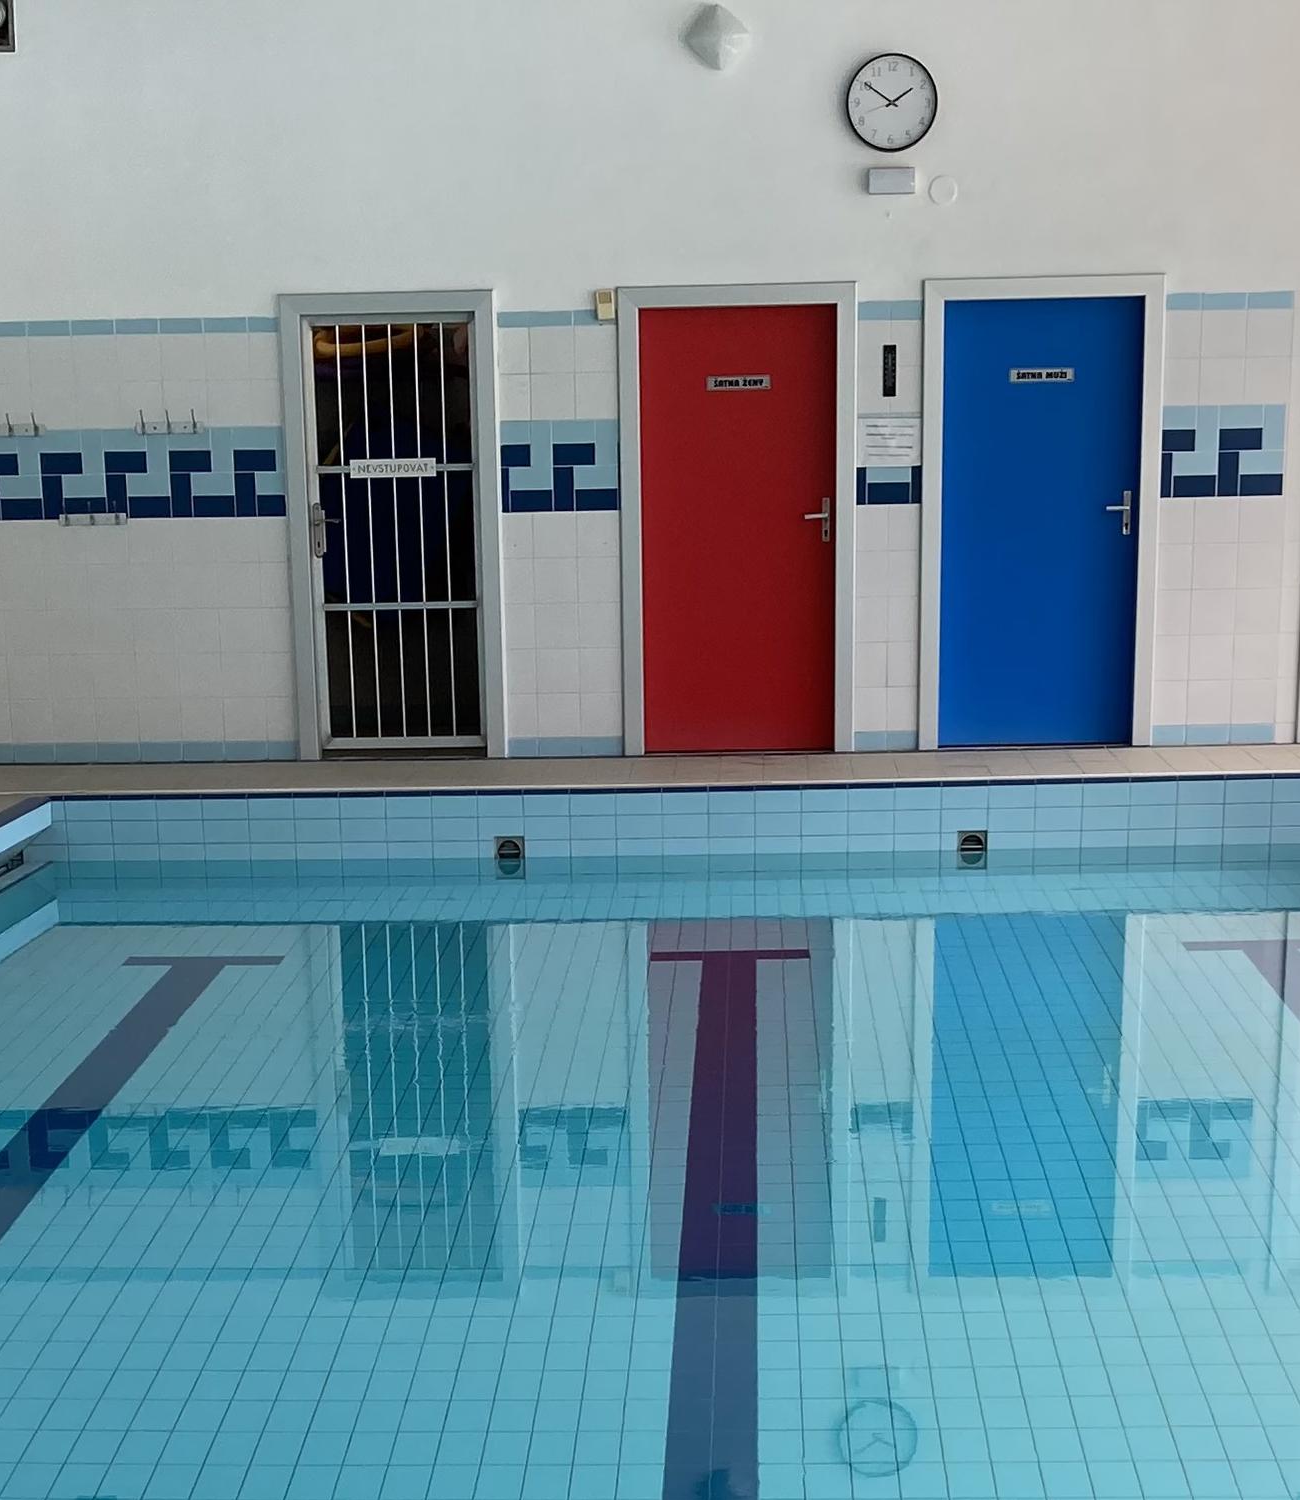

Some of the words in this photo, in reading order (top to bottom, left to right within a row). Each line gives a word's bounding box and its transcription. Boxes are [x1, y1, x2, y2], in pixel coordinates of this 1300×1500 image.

[871, 67, 882, 77] 11
[888, 61, 899, 72] 12
[357, 462, 429, 474] NEVSTUPOVAT
